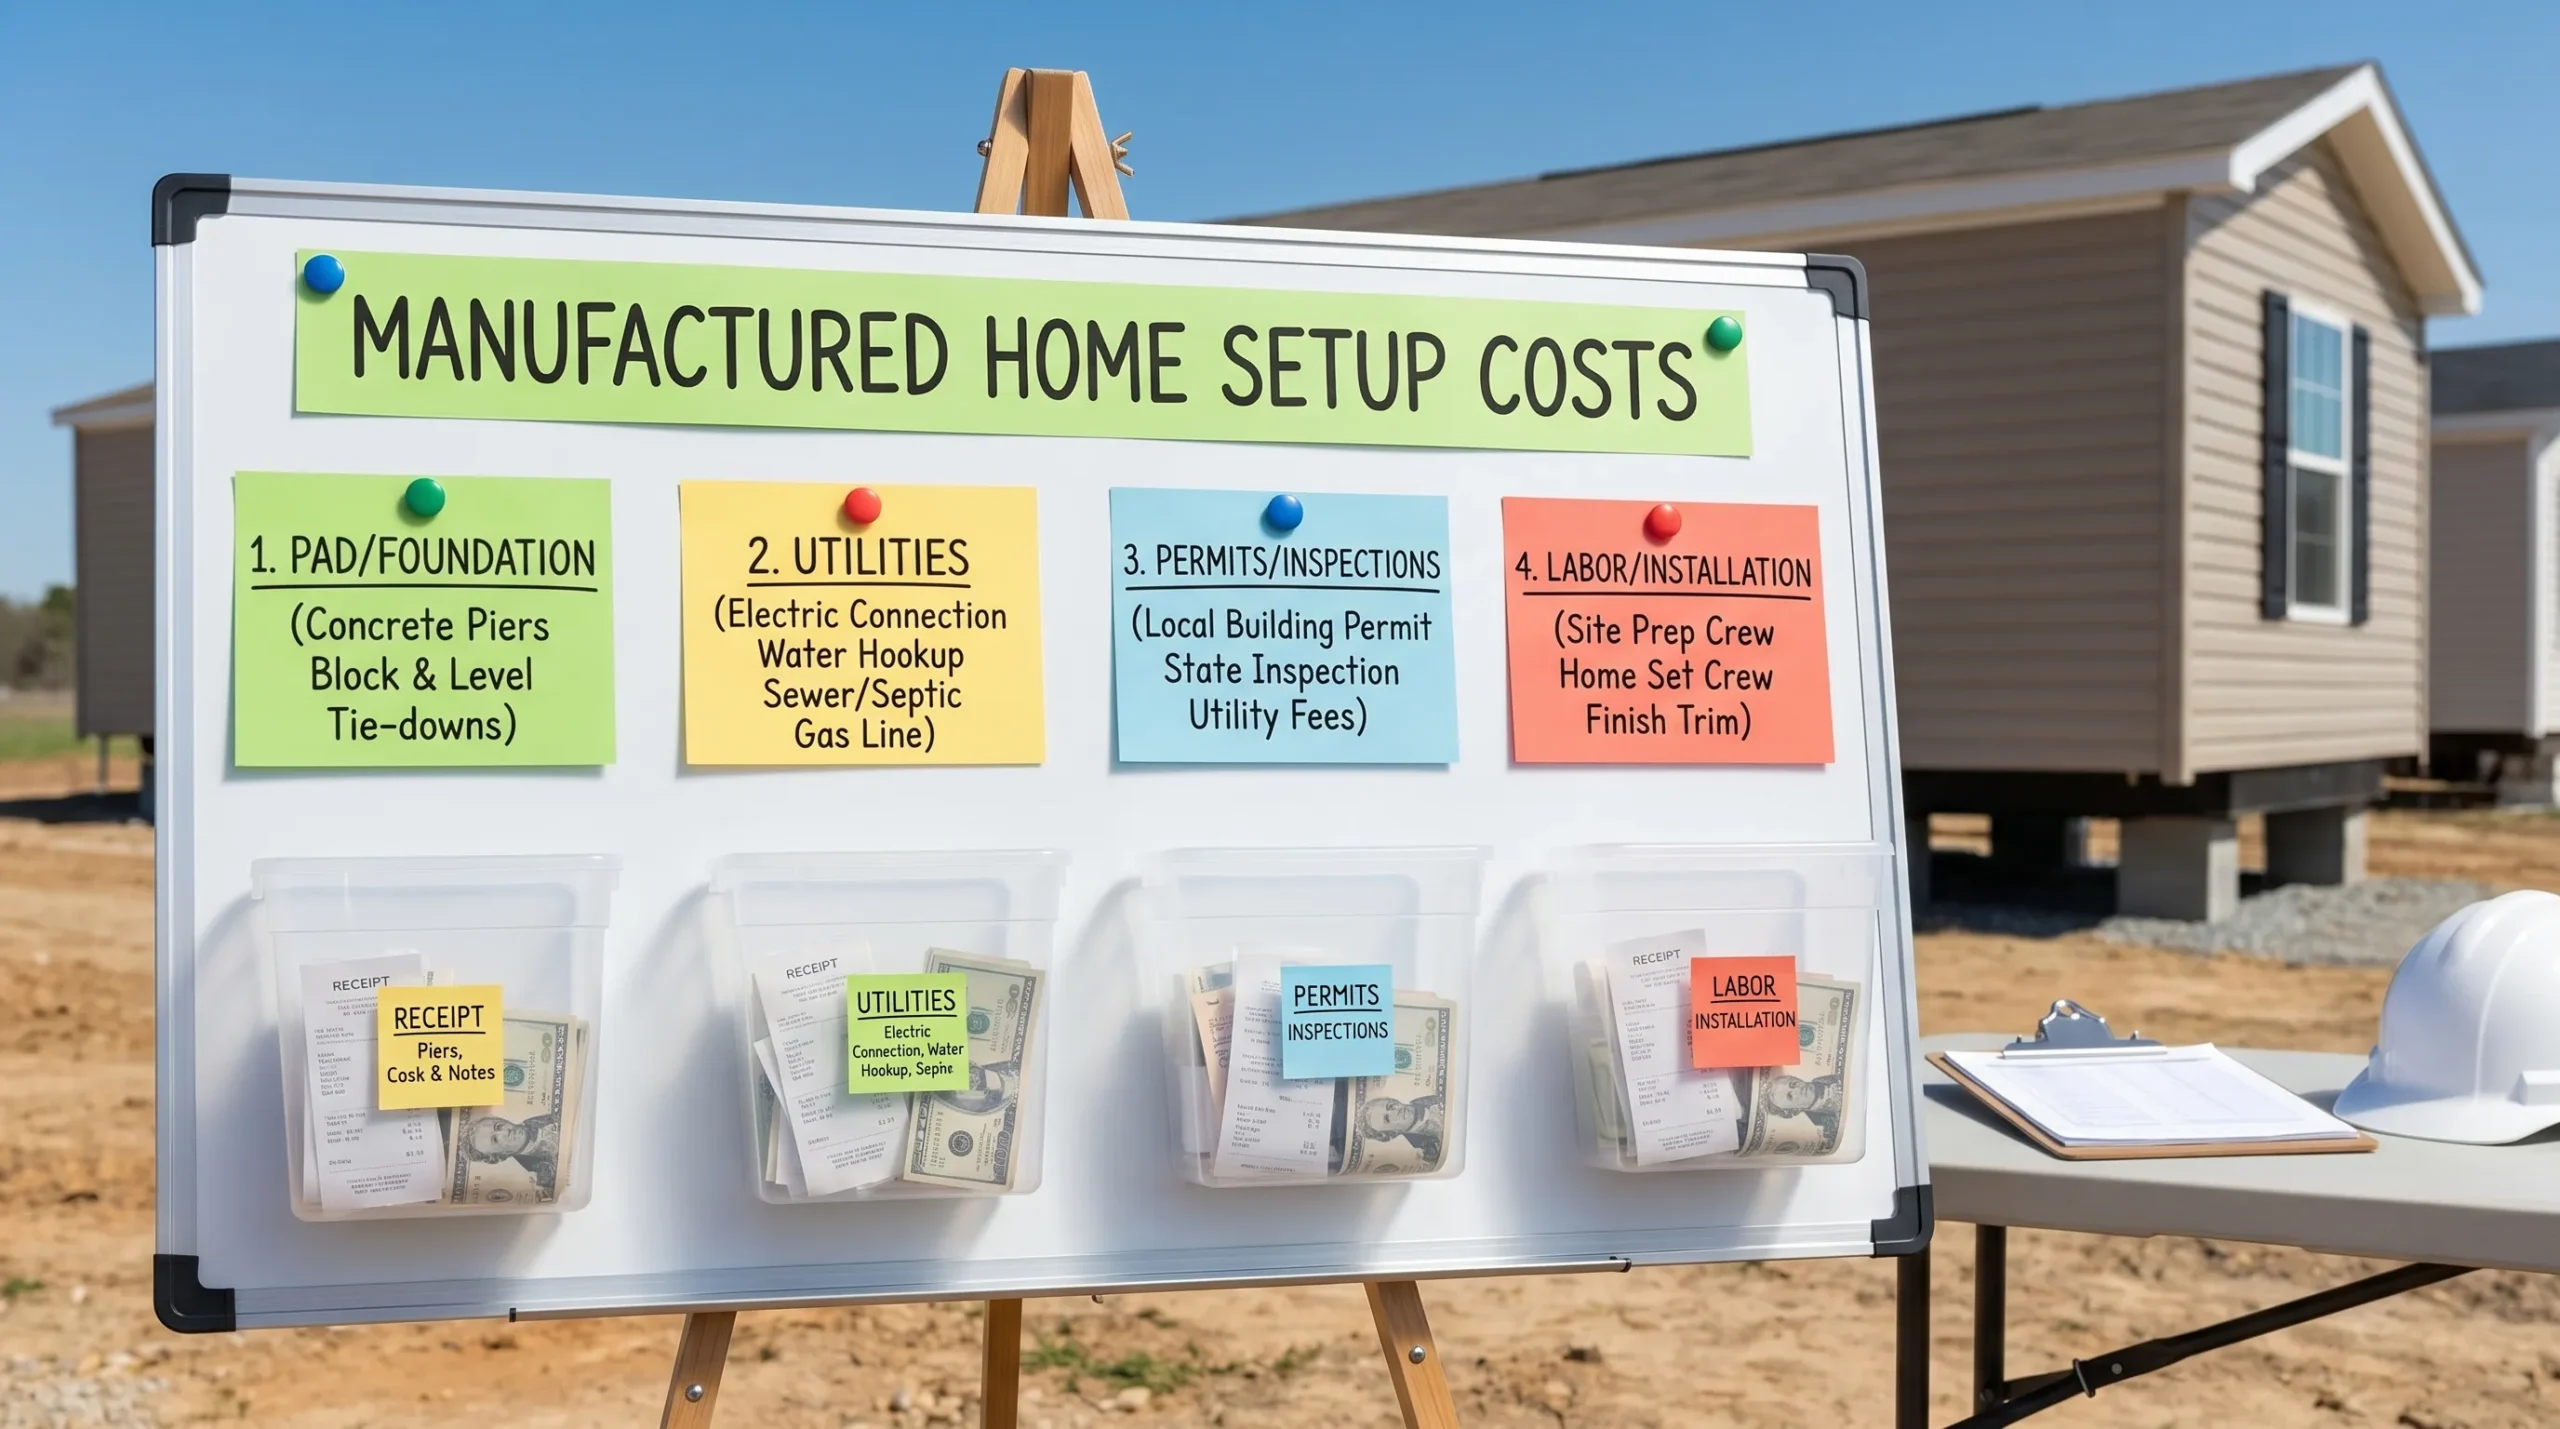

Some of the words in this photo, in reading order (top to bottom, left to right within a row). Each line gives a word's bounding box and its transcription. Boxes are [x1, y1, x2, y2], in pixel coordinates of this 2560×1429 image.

[353, 294, 949, 397] MANUFACTURED
[987, 315, 1188, 405] HOME
[1222, 325, 1447, 413] SETUP
[1480, 335, 1699, 423] COSTS
[250, 534, 277, 574] 1.
[291, 533, 595, 577] PAD/FOUNDATION
[748, 536, 780, 576] 2.
[794, 536, 970, 576] UTILITIES
[1123, 543, 1146, 576] 3.
[1157, 544, 1441, 580] PERMITS/INSPECTIONS
[1515, 551, 1538, 582] 4.
[1547, 551, 1812, 587] LABOR/INSTALLATION
[290, 602, 454, 647] (Concrete
[468, 606, 550, 642] Piers
[714, 594, 839, 633] (Electric
[850, 599, 1007, 630] Connection
[1132, 604, 1214, 643] (Local
[1227, 608, 1333, 649] Building
[1345, 610, 1433, 641] Permit
[1554, 609, 1622, 649] (Site
[1633, 613, 1695, 654] Prep
[1706, 615, 1775, 646] Crew
[311, 656, 400, 691] Block
[412, 656, 437, 691] &
[451, 656, 532, 691] Level
[757, 638, 848, 669] Water
[859, 638, 964, 677] Hookup
[1164, 652, 1242, 685] State
[1252, 653, 1400, 693] Inspection
[1560, 657, 1637, 690] Home
[1648, 658, 1694, 690] Set
[1705, 659, 1773, 691] Crew
[763, 677, 962, 718] Sewer/Septic
[327, 702, 516, 746] Tie-downs)
[795, 718, 850, 749] Gas
[862, 715, 935, 753] Line)
[1189, 697, 1279, 740] Utility
[1291, 696, 1367, 737] Fees)
[1586, 703, 1666, 735] Finish
[1677, 701, 1751, 741] Trim)
[786, 958, 839, 979] RECEIPT
[1633, 949, 1681, 966] RECEIPT
[333, 976, 390, 992] RECEIPT
[1294, 984, 1380, 1007] PERMITS
[1713, 975, 1777, 998] LABOR
[394, 1005, 485, 1030] RECEIPT
[857, 990, 956, 1014] UTILITIES
[884, 1025, 931, 1039] Electric
[1288, 1021, 1389, 1041] INSPECTIONS
[1695, 1011, 1796, 1030] INSTALLATION
[418, 1042, 464, 1061] Piers,
[853, 1045, 925, 1059] Connection,
[927, 1043, 964, 1057] Water
[387, 1066, 426, 1084] Cosk
[431, 1067, 443, 1082] &
[449, 1065, 496, 1082] Notes
[861, 1063, 913, 1079] Hookup,
